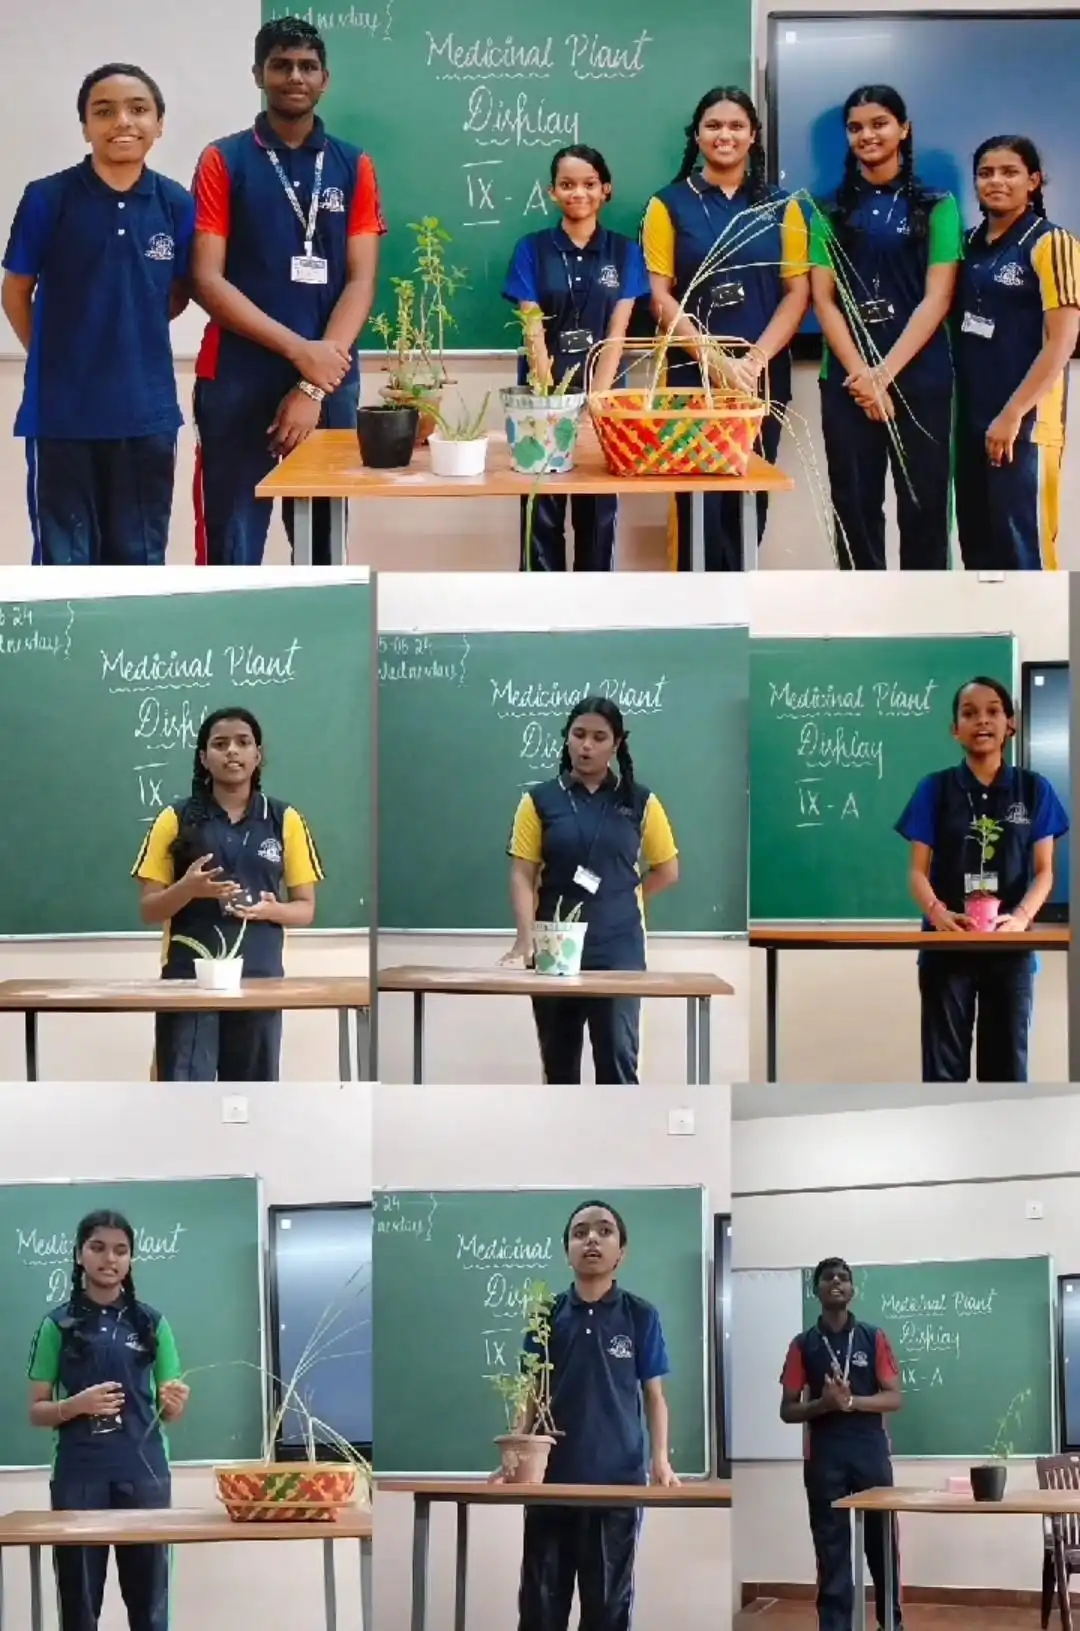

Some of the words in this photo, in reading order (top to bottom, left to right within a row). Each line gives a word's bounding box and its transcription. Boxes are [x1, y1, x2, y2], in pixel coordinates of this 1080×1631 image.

[426, 31, 554, 69] Medicinal
[564, 29, 653, 71] Plant
[462, 171, 495, 212] IX
[522, 179, 550, 217] A
[101, 648, 213, 681] Medicinal
[224, 638, 303, 678] Plant
[599, 675, 670, 708] Plant
[769, 681, 865, 709] Medicinal
[872, 678, 939, 710] Plant
[138, 773, 163, 807] IX
[798, 786, 821, 817] IX
[840, 791, 860, 820] A
[456, 1234, 553, 1261] Medicinal
[485, 1337, 507, 1368] IX
